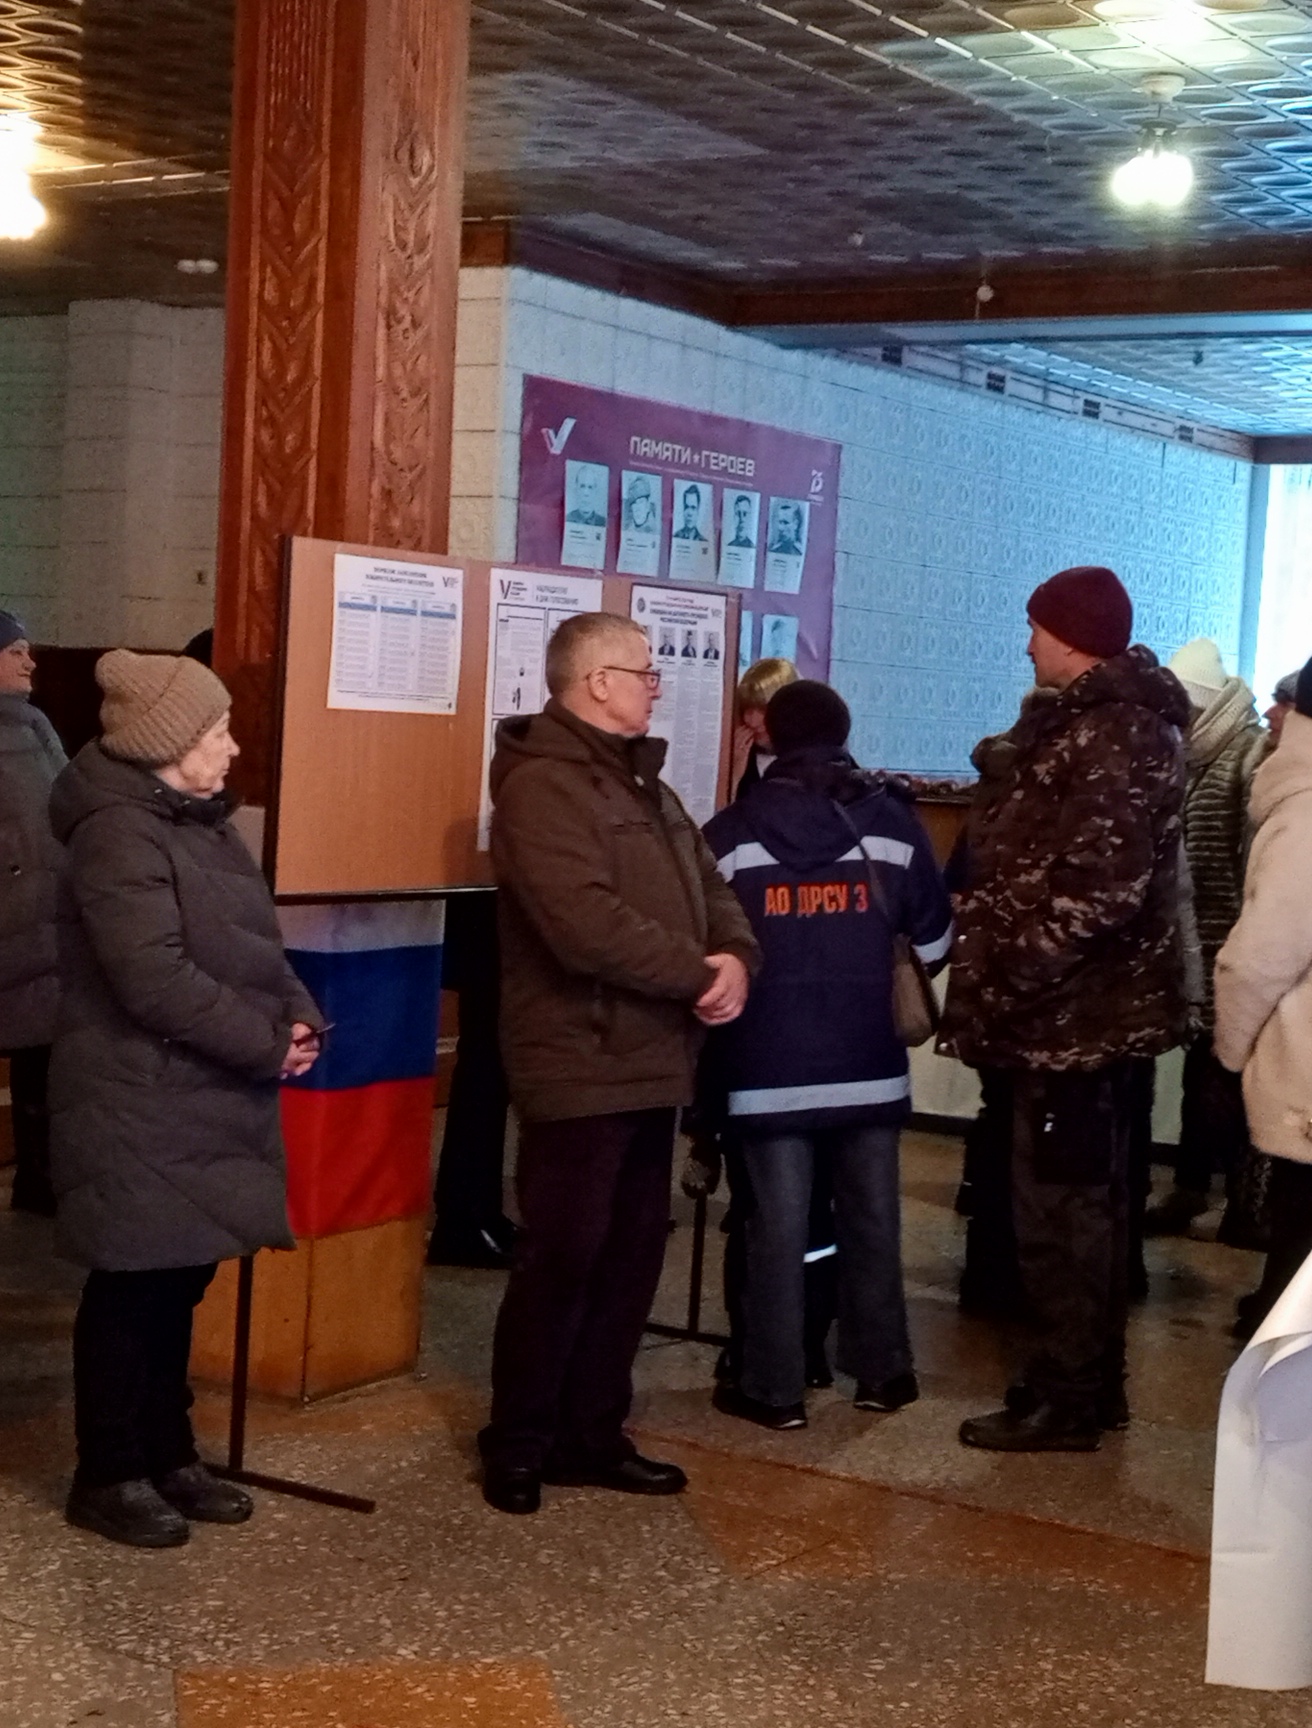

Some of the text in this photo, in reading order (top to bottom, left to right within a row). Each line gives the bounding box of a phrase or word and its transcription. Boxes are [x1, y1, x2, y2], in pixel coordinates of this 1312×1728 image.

[630, 436, 691, 464] ПАМЯТИ
[701, 450, 755, 477] ГЕРОЕВ
[764, 883, 868, 918] АО ДРСУ 3
